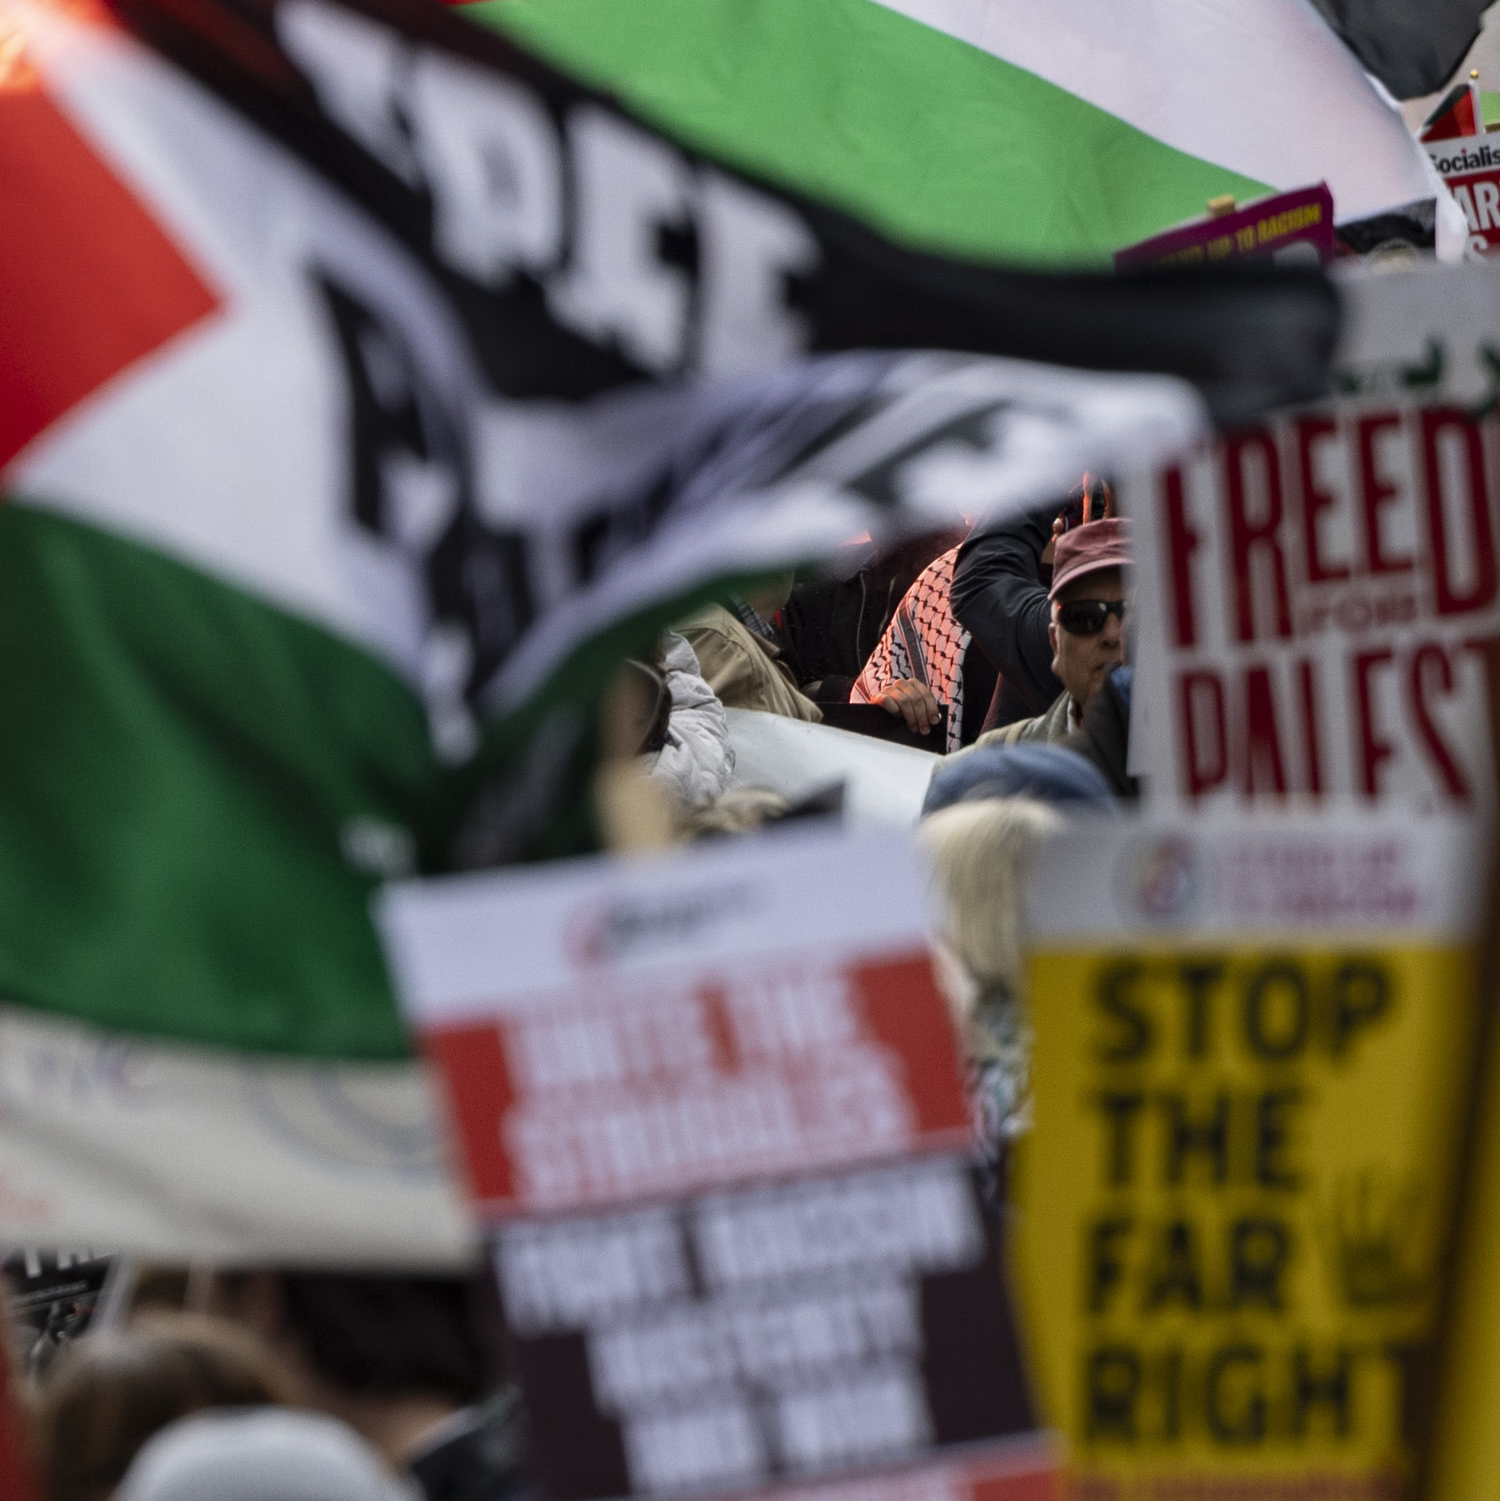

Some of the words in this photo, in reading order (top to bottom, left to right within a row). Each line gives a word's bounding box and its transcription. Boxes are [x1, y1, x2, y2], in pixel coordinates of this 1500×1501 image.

[1257, 202, 1322, 244] RACISM
[1090, 958, 1392, 1067] STOP
[1095, 1092, 1303, 1192] THE
[1085, 1215, 1290, 1315] FAR
